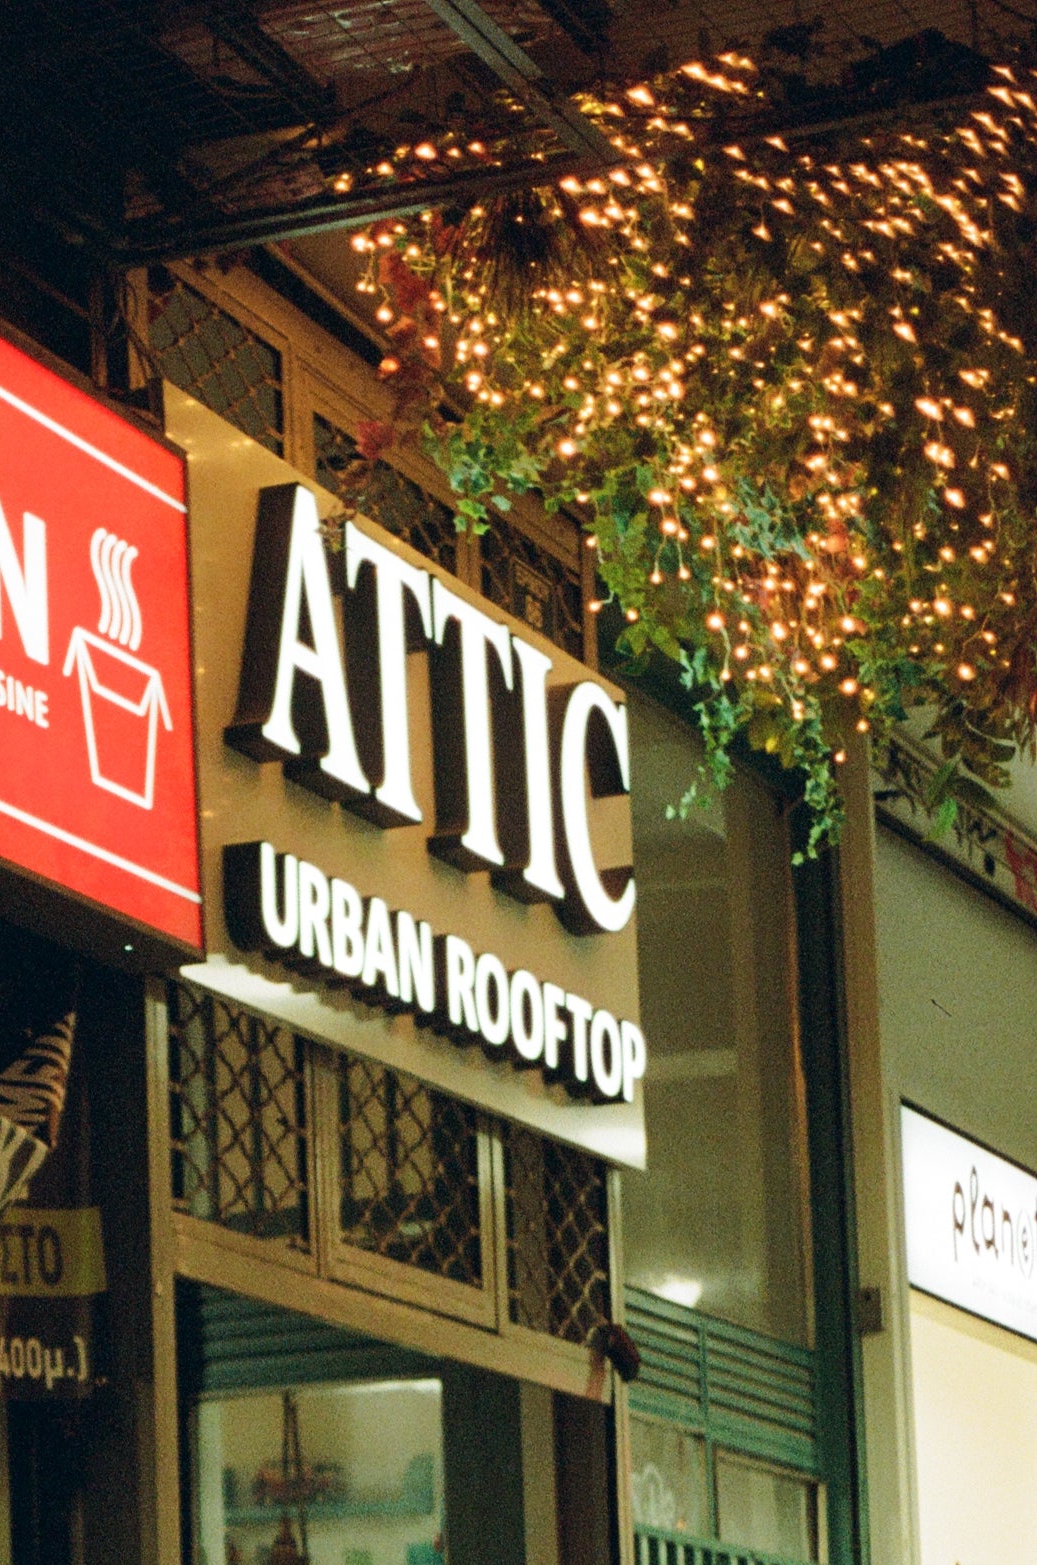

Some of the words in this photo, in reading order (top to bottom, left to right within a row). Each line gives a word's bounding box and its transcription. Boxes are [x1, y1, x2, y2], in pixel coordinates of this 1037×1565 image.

[261, 485, 636, 933] ATTIC
[261, 841, 434, 1014] URBAN
[446, 934, 647, 1104] ROOFTOP
[0, 1223, 62, 1286] ΣΤΟ
